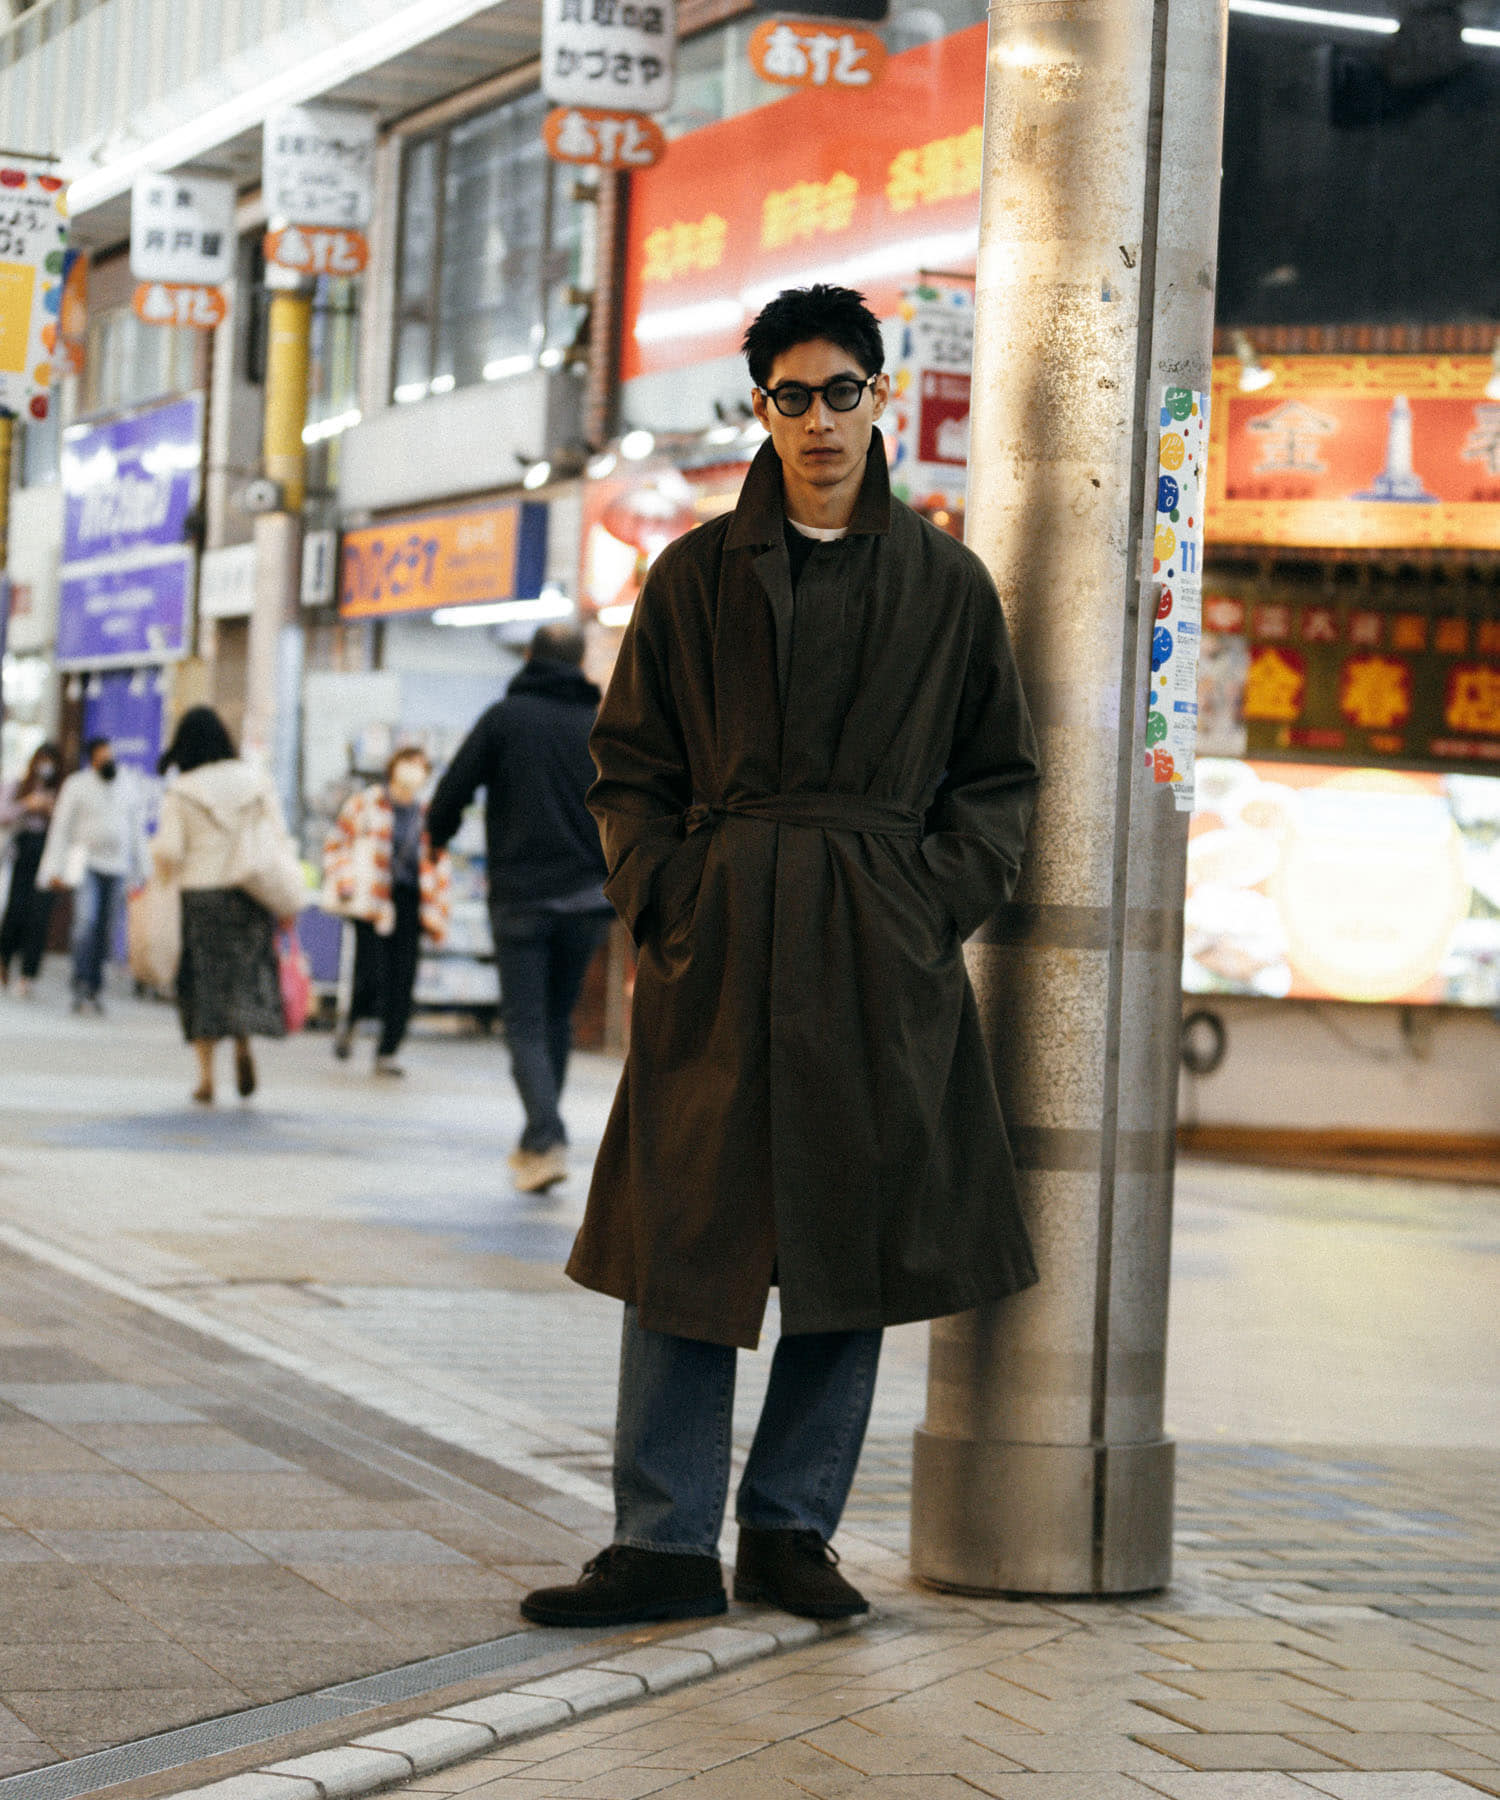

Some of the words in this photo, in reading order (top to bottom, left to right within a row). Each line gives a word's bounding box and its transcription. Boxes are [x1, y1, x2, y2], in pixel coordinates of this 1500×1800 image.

[556, 48, 663, 84] かづさや
[762, 25, 872, 86] あすと
[556, 111, 656, 164] あすと
[275, 226, 361, 271] あすと
[142, 284, 219, 325] あすと
